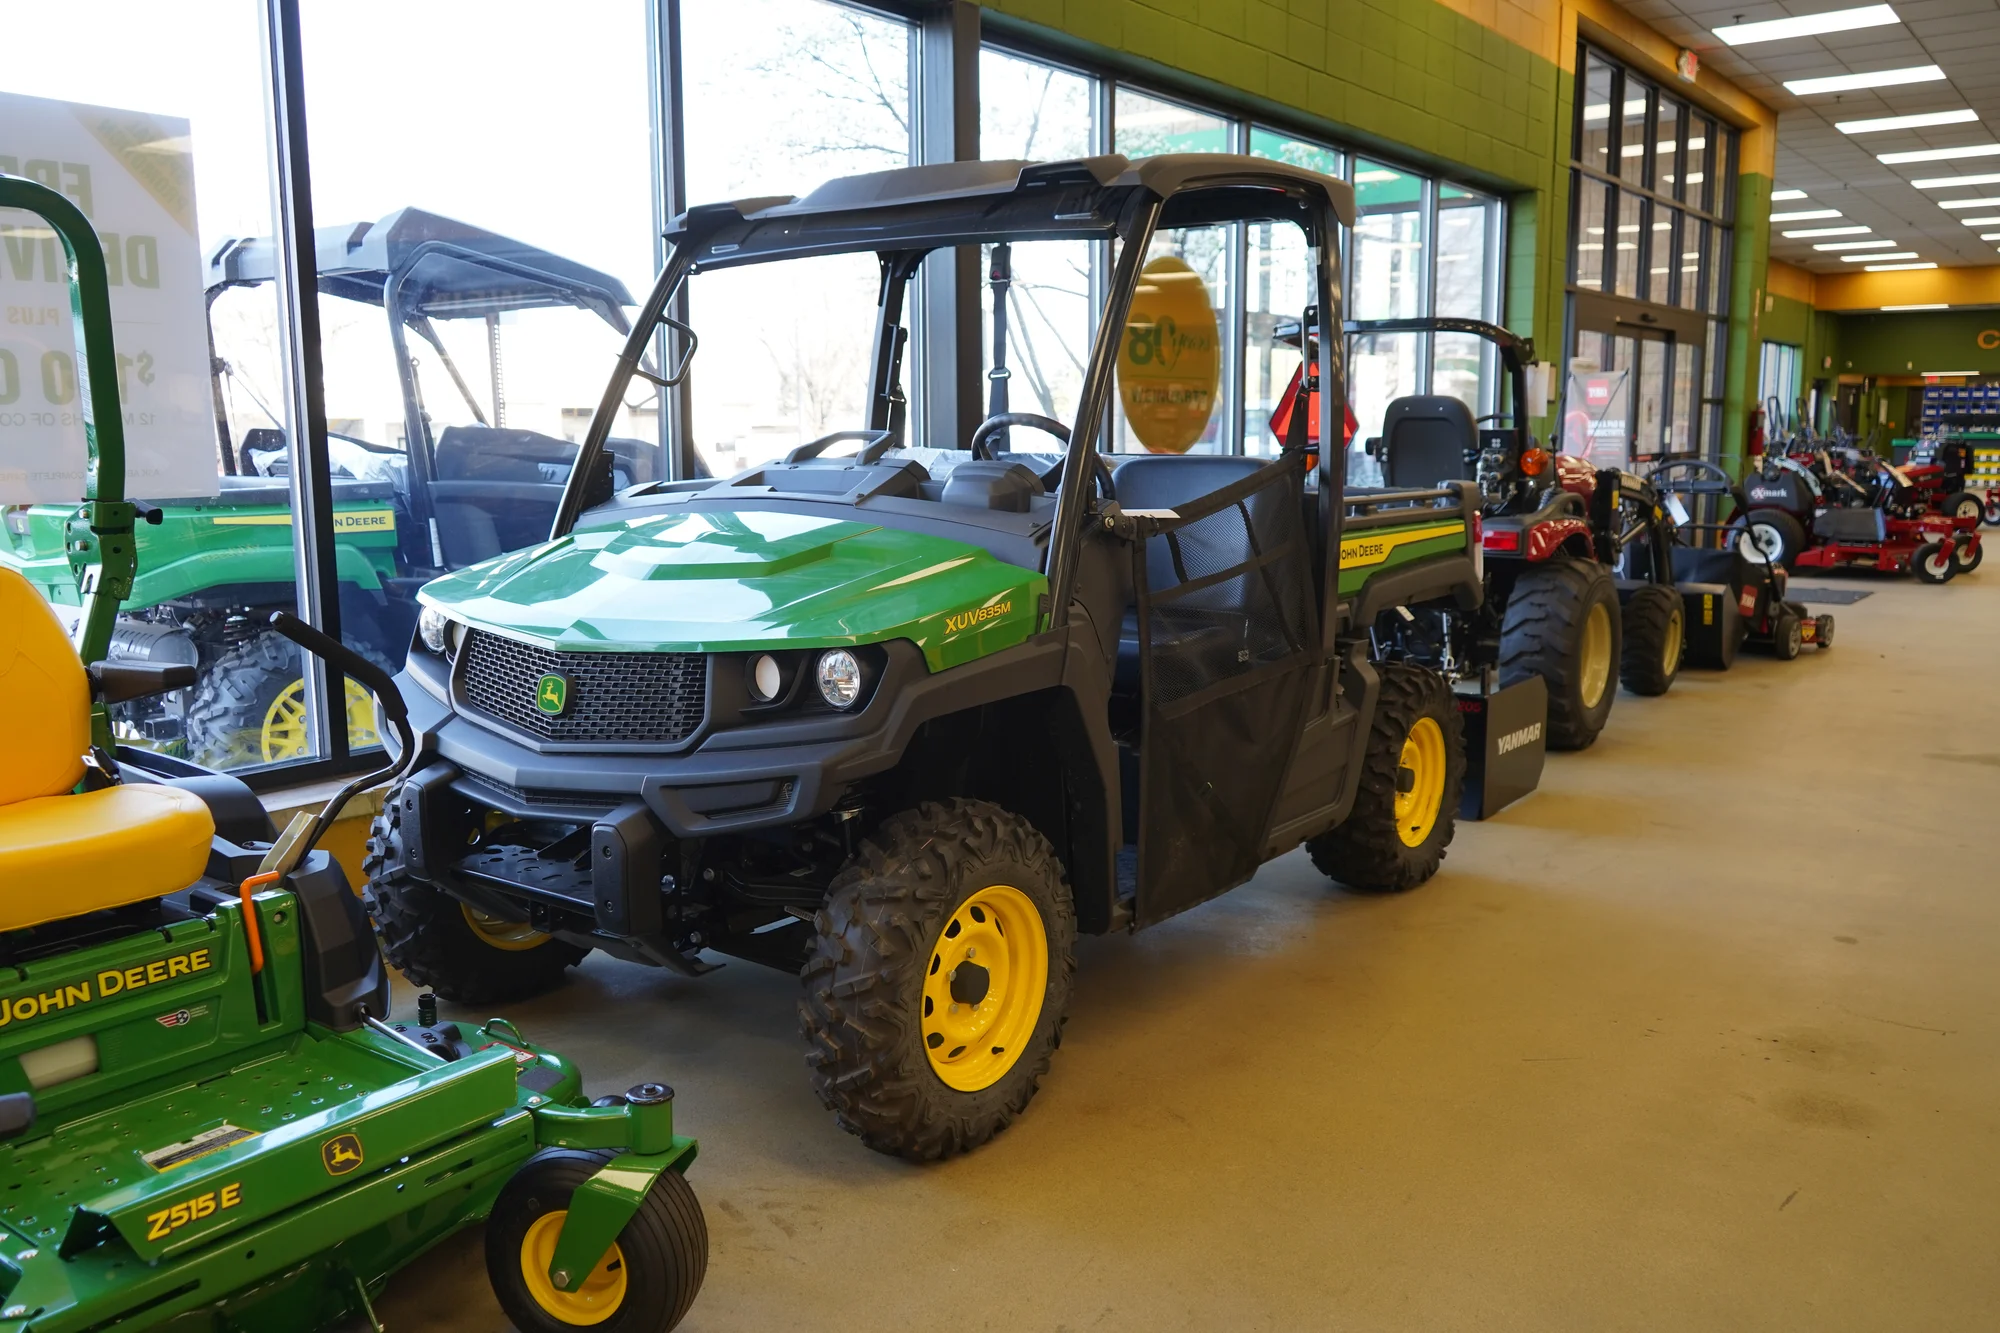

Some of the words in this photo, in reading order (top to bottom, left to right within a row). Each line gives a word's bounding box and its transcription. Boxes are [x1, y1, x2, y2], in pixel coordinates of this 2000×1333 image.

[345, 516, 386, 527] DEERE
[1340, 547, 1358, 560] OHN
[1359, 543, 1384, 558] DEERE
[943, 601, 1011, 636] XUV835M
[1497, 722, 1542, 756] YANMAR
[0, 980, 91, 1028] JOHN
[97, 948, 212, 999] DEERE
[147, 1191, 217, 1242] Z515
[221, 1182, 242, 1210] E
